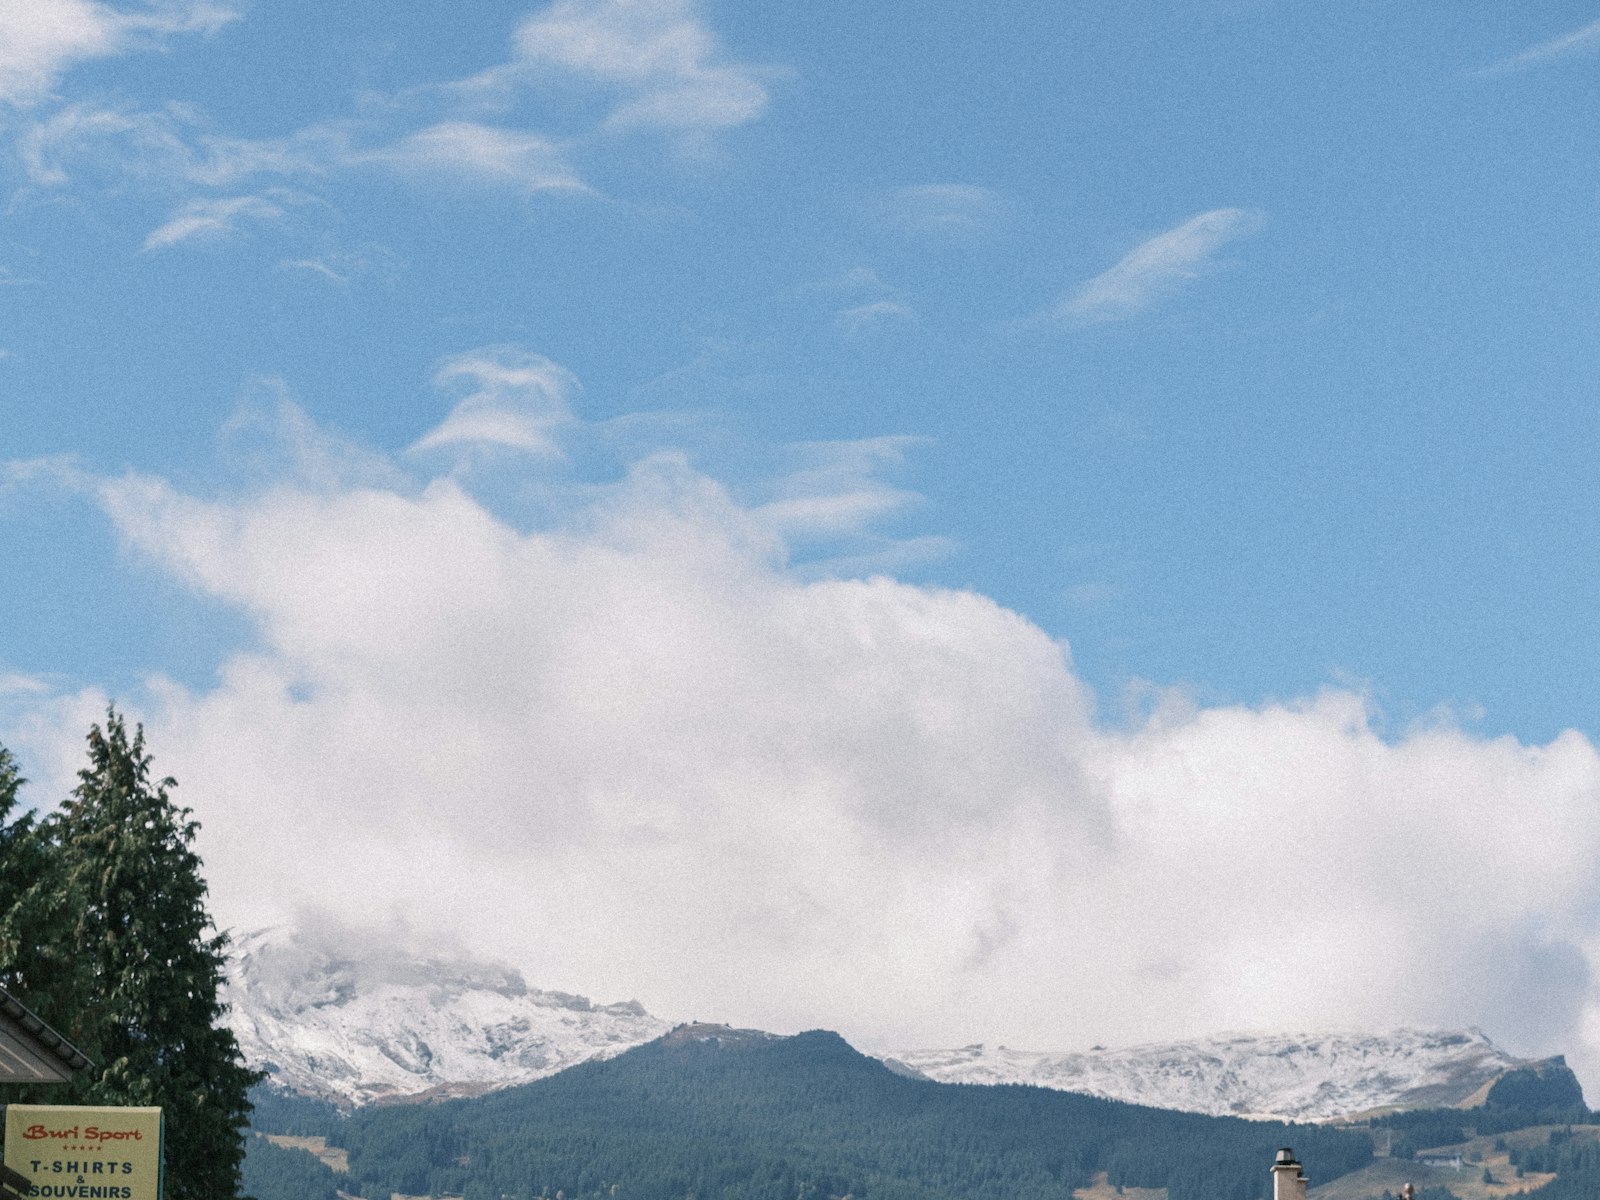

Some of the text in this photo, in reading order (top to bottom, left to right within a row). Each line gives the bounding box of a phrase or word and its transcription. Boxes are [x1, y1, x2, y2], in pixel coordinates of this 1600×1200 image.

[22, 1125, 143, 1142] Buri Sport
[30, 1160, 133, 1175] T-SHIRTS
[76, 1175, 85, 1184] &
[29, 1185, 132, 1199] SOUVENIRS
